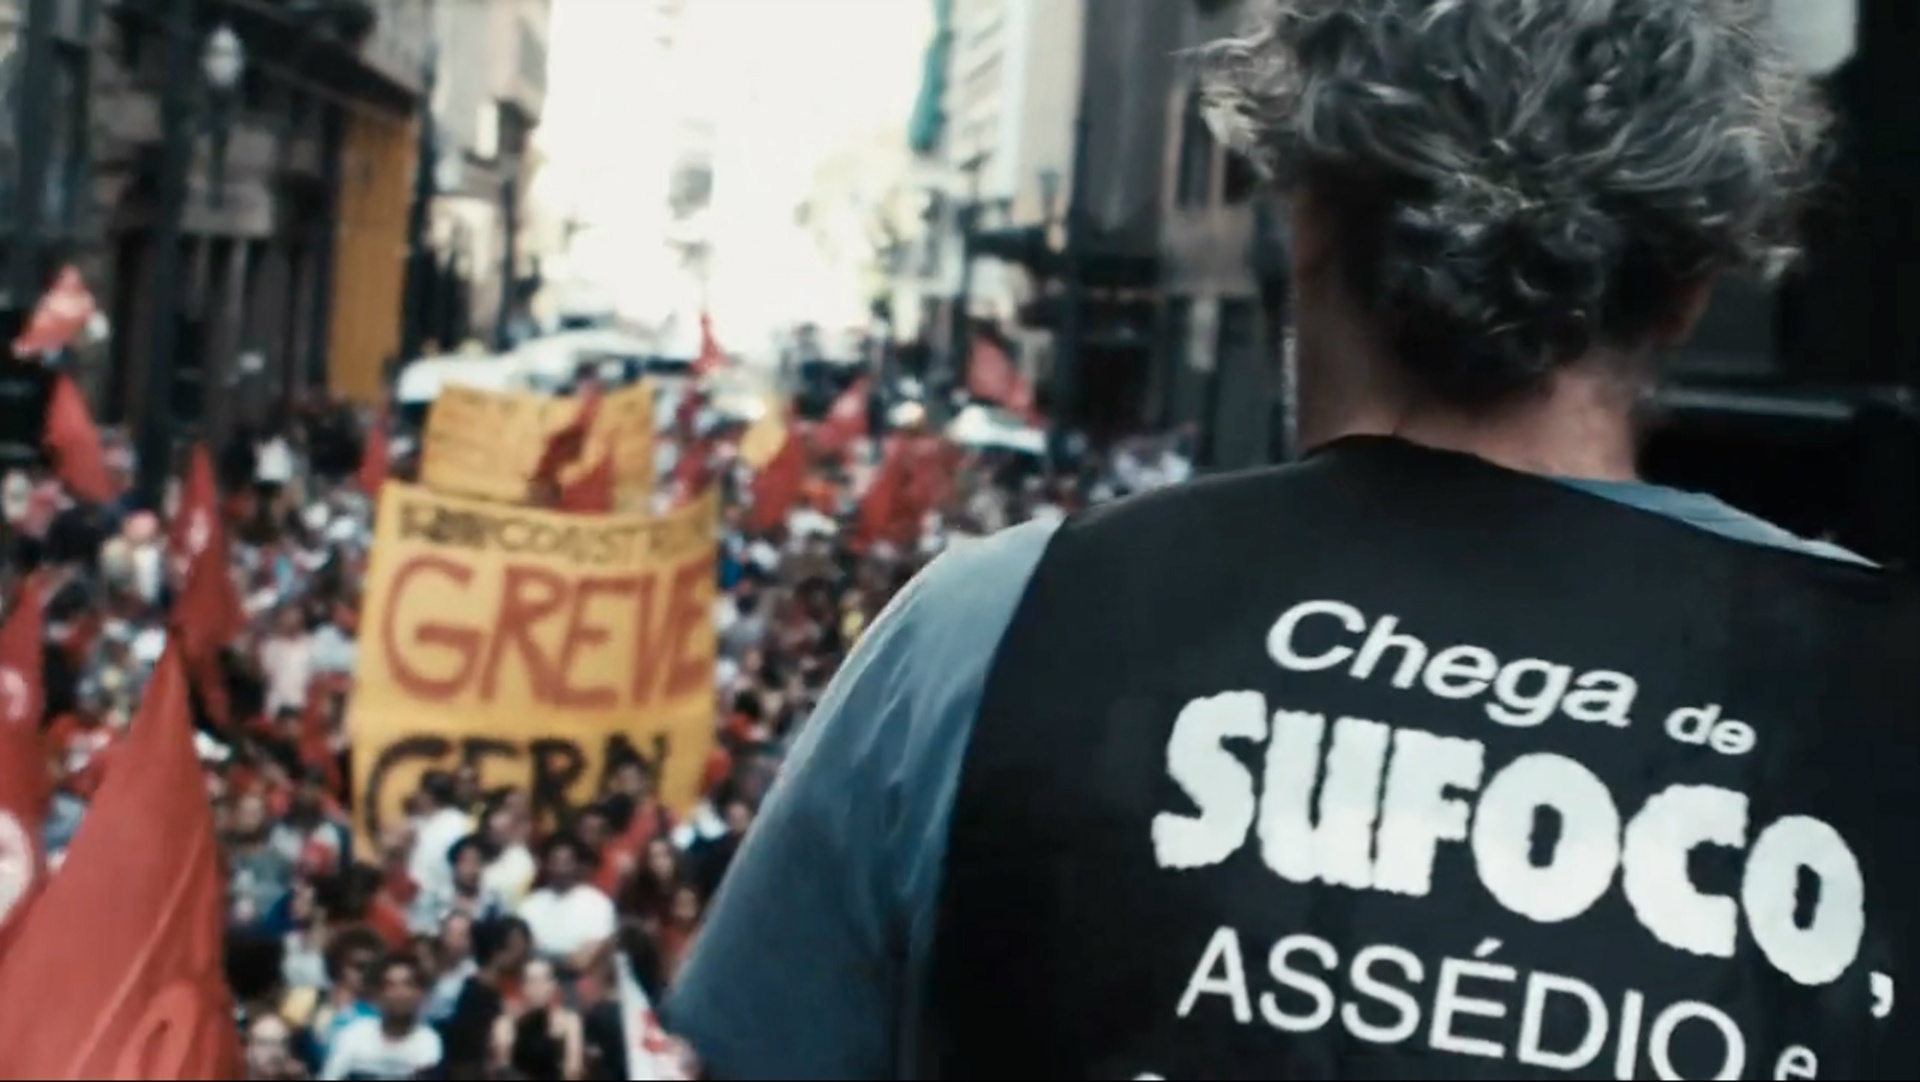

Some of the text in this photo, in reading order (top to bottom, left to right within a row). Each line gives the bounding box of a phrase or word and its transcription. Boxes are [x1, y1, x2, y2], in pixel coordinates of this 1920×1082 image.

[382, 548, 714, 709] GREVE
[1266, 599, 1757, 756] Chega de
[1151, 689, 1895, 1019] SUFOCO,
[1176, 926, 1747, 1082] ASSÉDIO
